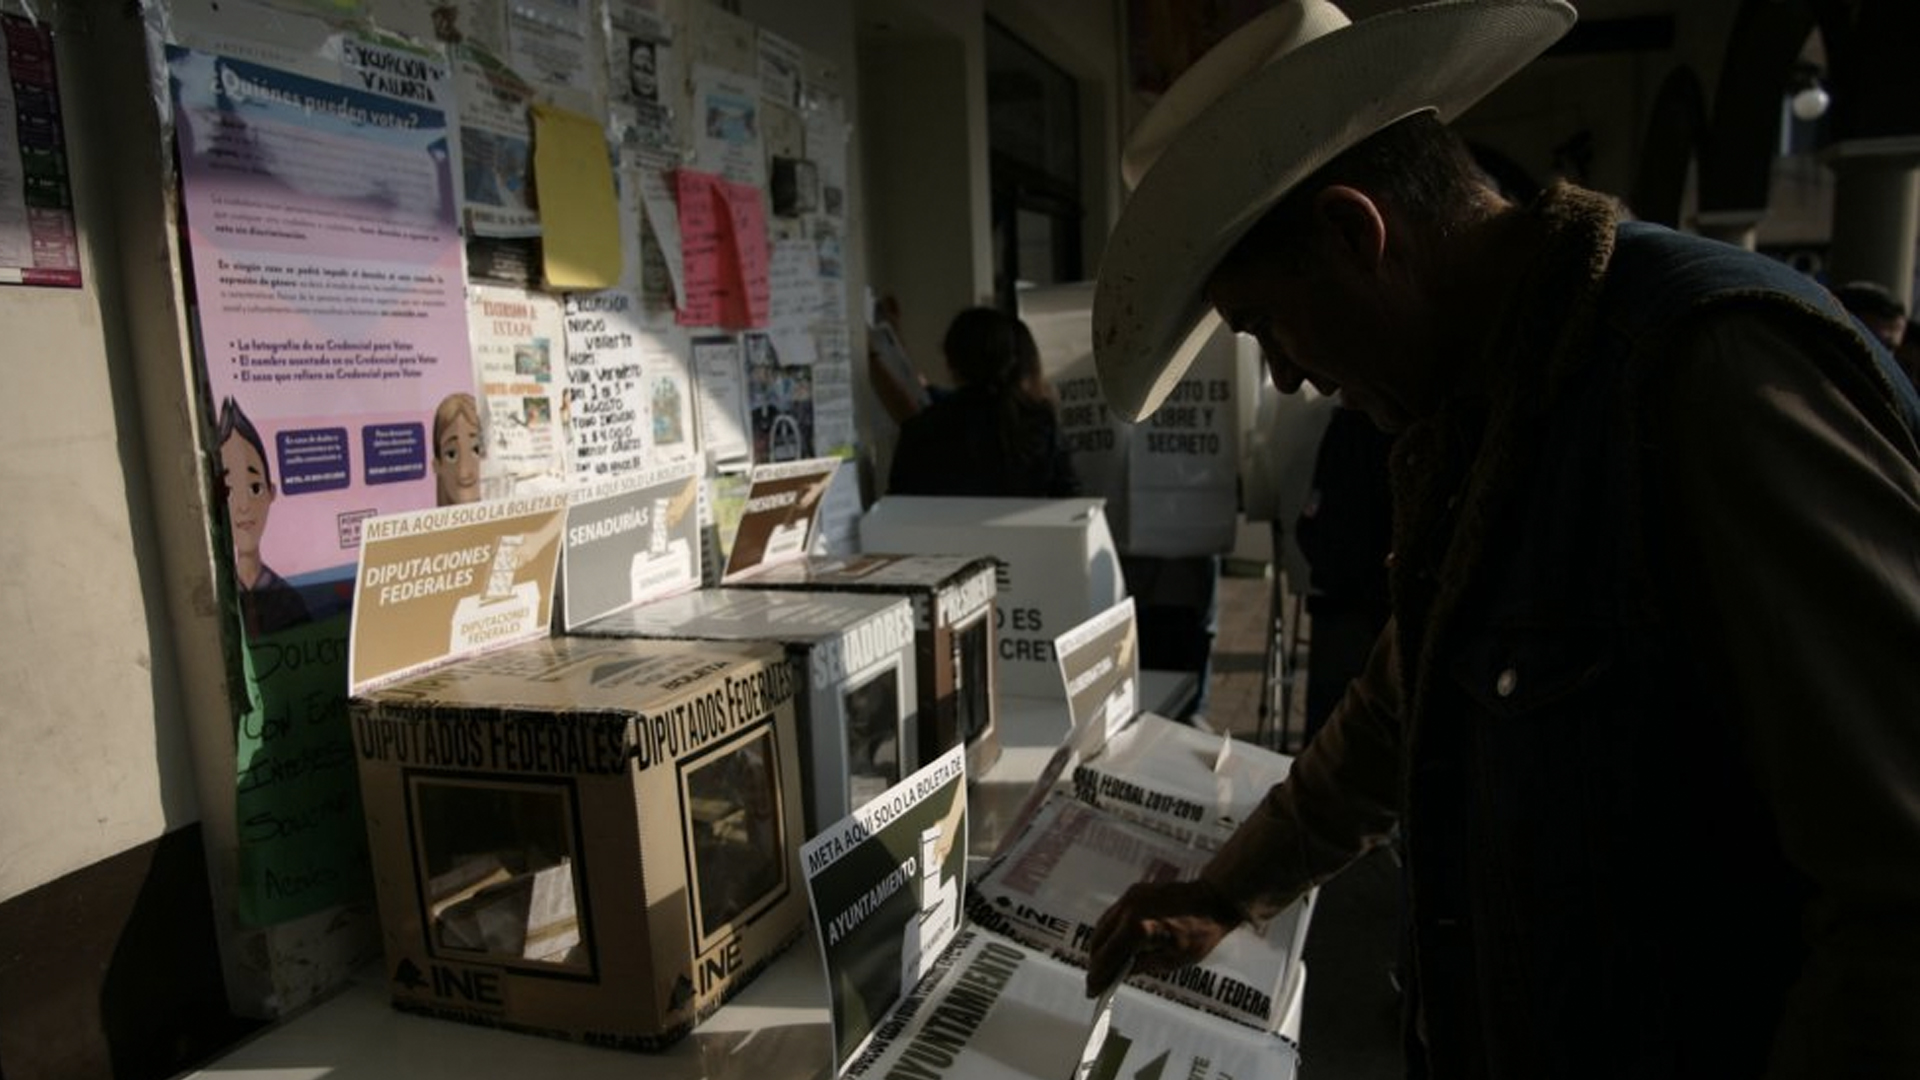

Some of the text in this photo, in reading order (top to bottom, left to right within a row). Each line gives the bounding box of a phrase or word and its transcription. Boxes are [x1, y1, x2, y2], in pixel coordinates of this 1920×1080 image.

[211, 62, 419, 129] ¿Quiénes pueden votar?
[327, 338, 372, 350] Credencial
[355, 353, 398, 365] Credencial
[336, 367, 381, 379] Credencial
[1209, 380, 1230, 401] ES
[1204, 407, 1213, 426] Y
[1148, 433, 1219, 455] SECRETO
[367, 519, 410, 539] META
[412, 513, 450, 532] AQUÍ
[451, 506, 487, 525] SOLO
[489, 503, 505, 519] LA
[507, 497, 551, 516] BOLETA
[569, 506, 649, 548] SENADURÍAS
[365, 544, 491, 588] DIPUTACIONES
[379, 567, 474, 606] FEDERALES
[460, 606, 530, 636] DIPUTACIONES
[468, 622, 521, 644] FEDERALES
[1012, 608, 1043, 631] ES
[635, 688, 727, 771] DIPUTADOS
[725, 661, 793, 728] FEDERALES
[355, 711, 627, 773] DIPUTADOS FEDERALES
[808, 755, 962, 873] META AQUÍ SOLO LA BOLETA DE
[828, 856, 917, 947] AYUNTAMIENTO
[1017, 905, 1070, 934] INE
[432, 965, 499, 1004] INE
[699, 940, 744, 996] INE
